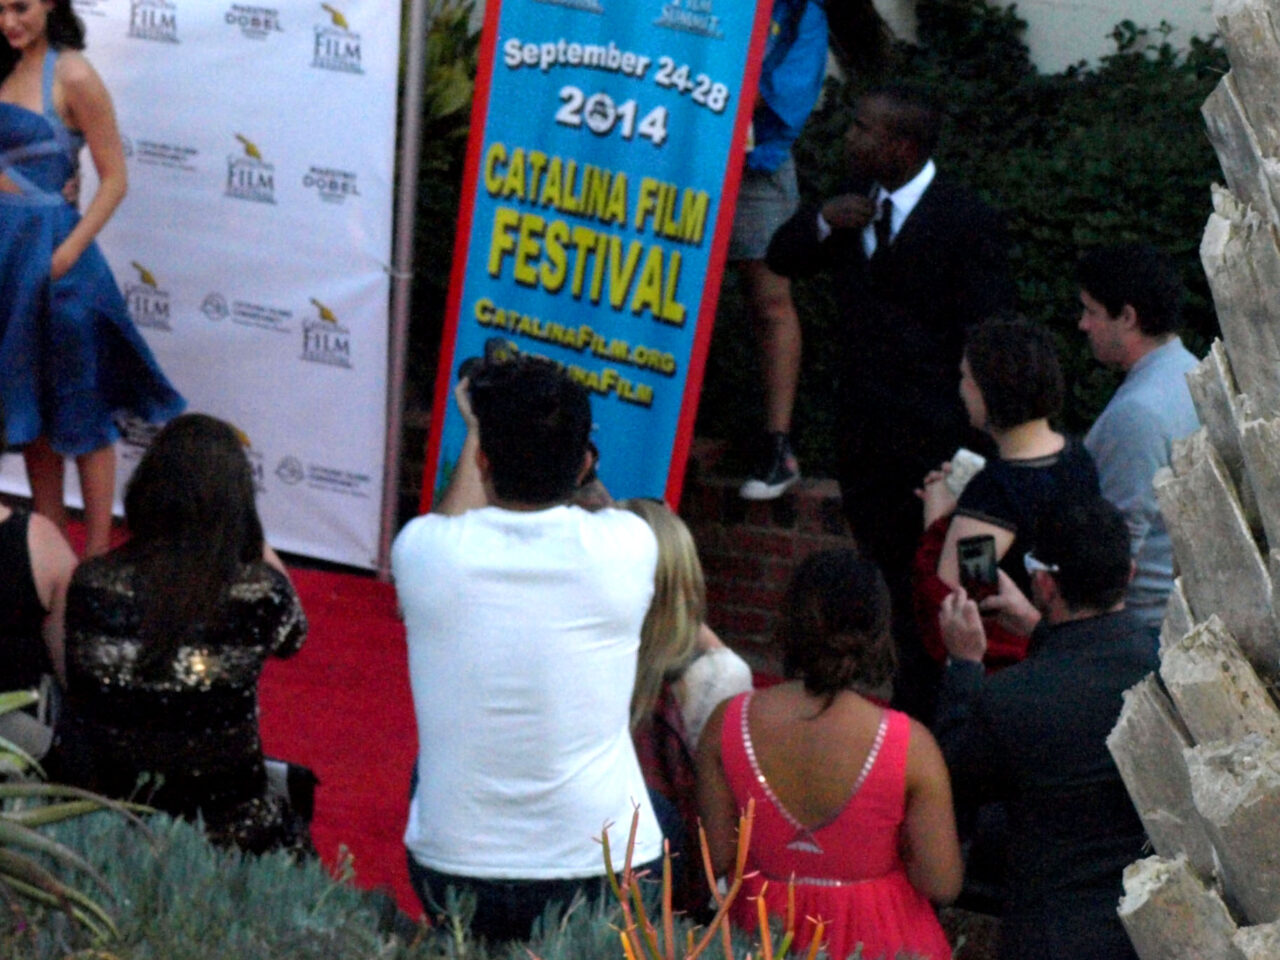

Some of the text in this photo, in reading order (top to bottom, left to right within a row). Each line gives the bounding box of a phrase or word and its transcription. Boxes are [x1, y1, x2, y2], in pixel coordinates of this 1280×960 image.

[504, 37, 730, 112] September 24-28
[556, 86, 668, 144] 2014
[484, 142, 710, 244] CATALINA FILM
[488, 207, 687, 324] FESTIVAL
